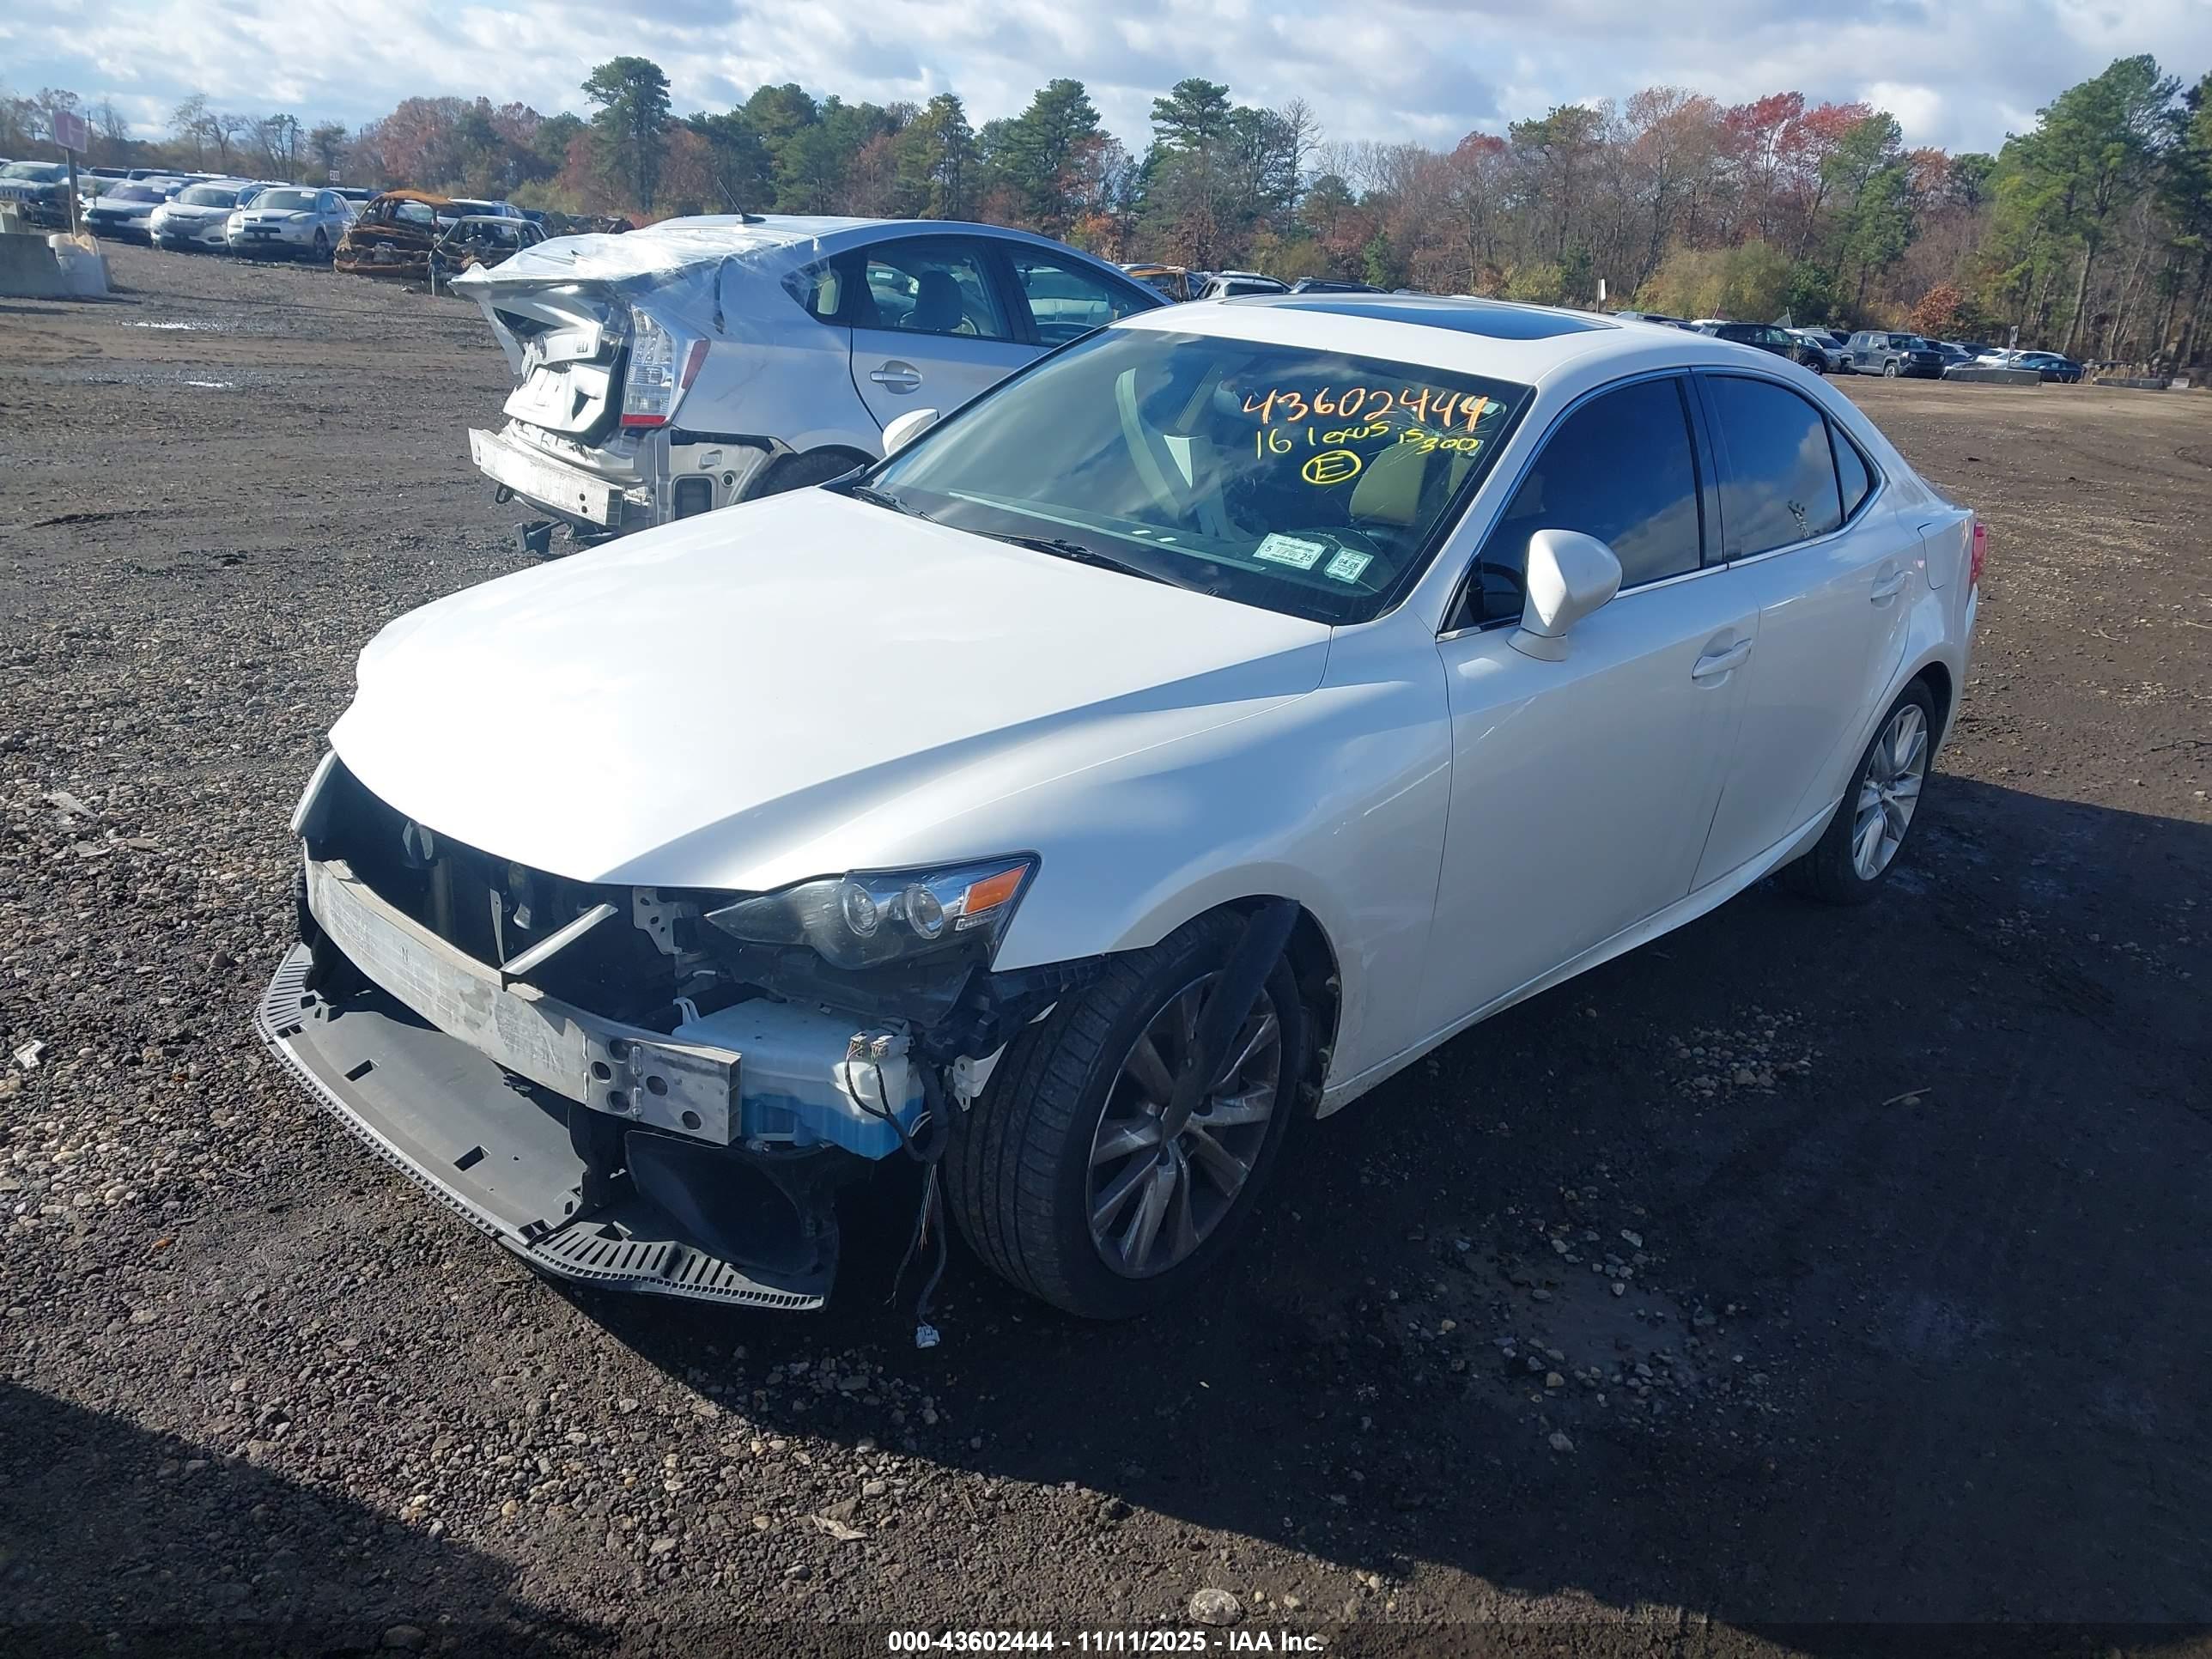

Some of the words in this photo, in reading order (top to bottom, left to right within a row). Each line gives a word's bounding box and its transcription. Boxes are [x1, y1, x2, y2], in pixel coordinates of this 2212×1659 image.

[1243, 387, 1488, 433] 43602444
[1257, 428, 1292, 459] 16
[1416, 436, 1478, 455] 300
[1299, 552, 1314, 562] 25
